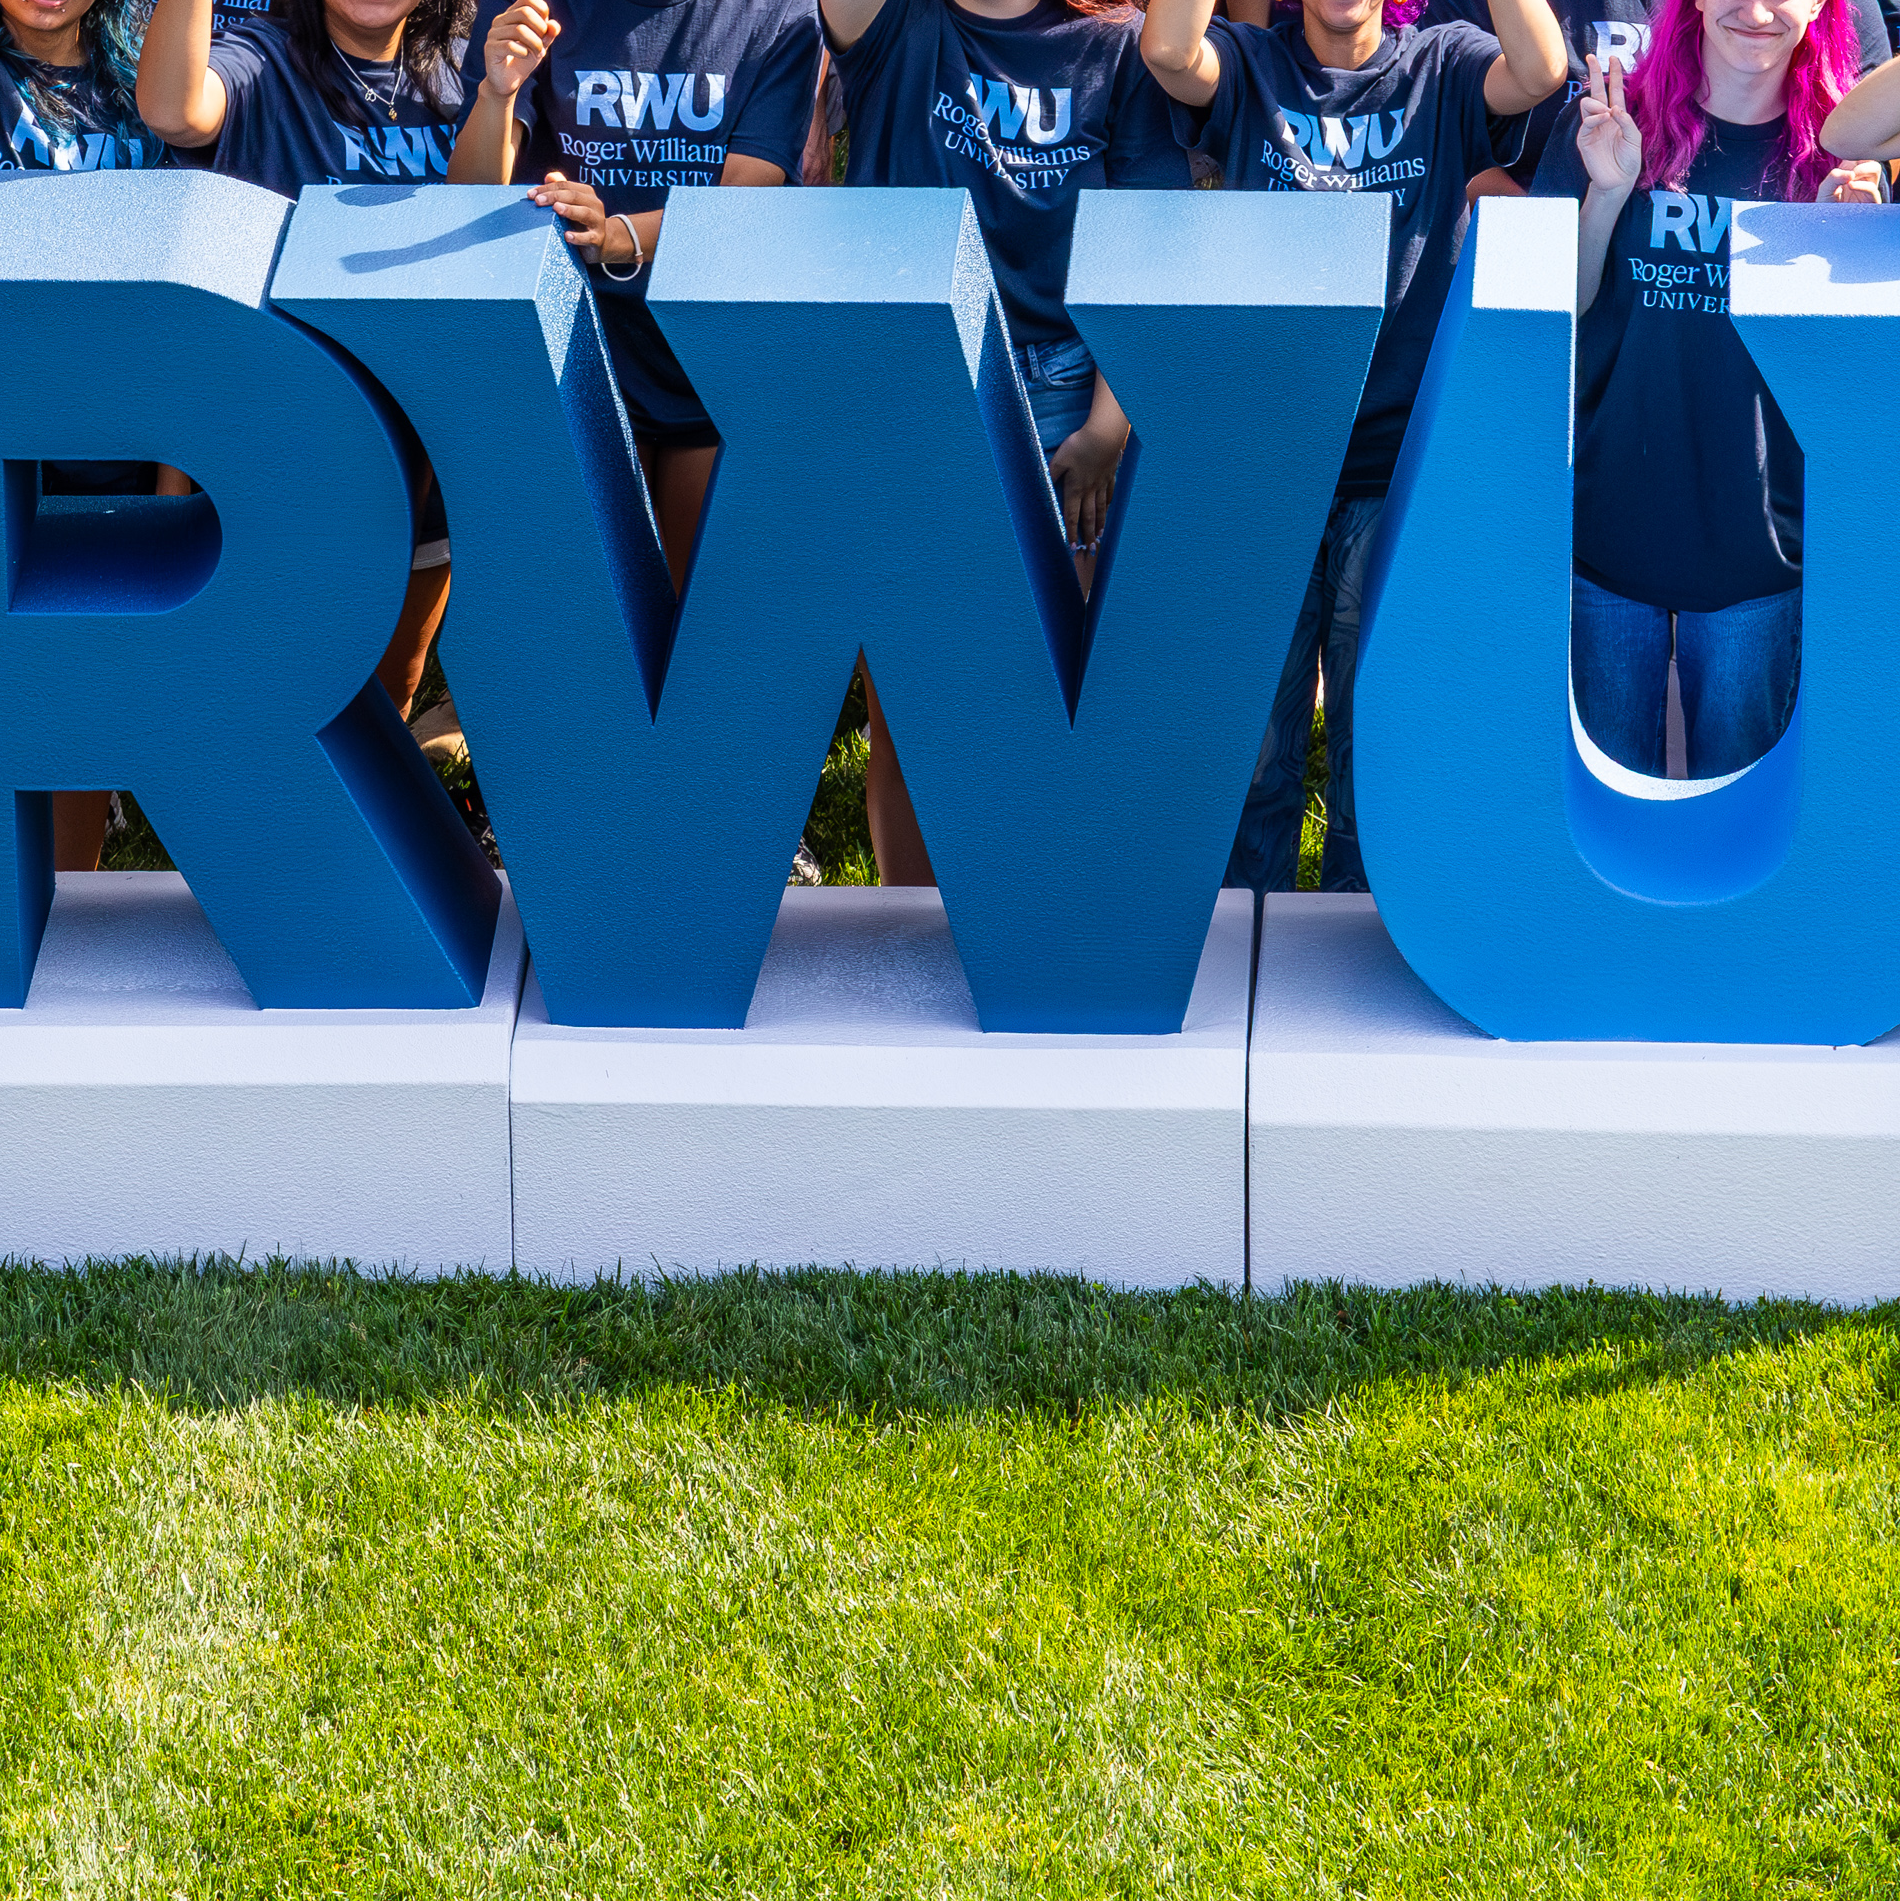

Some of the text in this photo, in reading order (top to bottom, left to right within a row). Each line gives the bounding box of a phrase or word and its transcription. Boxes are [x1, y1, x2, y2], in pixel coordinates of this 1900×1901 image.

[574, 70, 727, 131] RWU
[334, 121, 456, 176] RWU
[558, 132, 624, 166] Roger
[1277, 107, 1406, 170] RWU
[577, 166, 714, 188] UNIVERSITY
[1261, 141, 1426, 191] Roger Williams
[1649, 189, 1733, 252] RW
[1628, 257, 1700, 286] Roger
[1641, 289, 1731, 315] UNIVER
